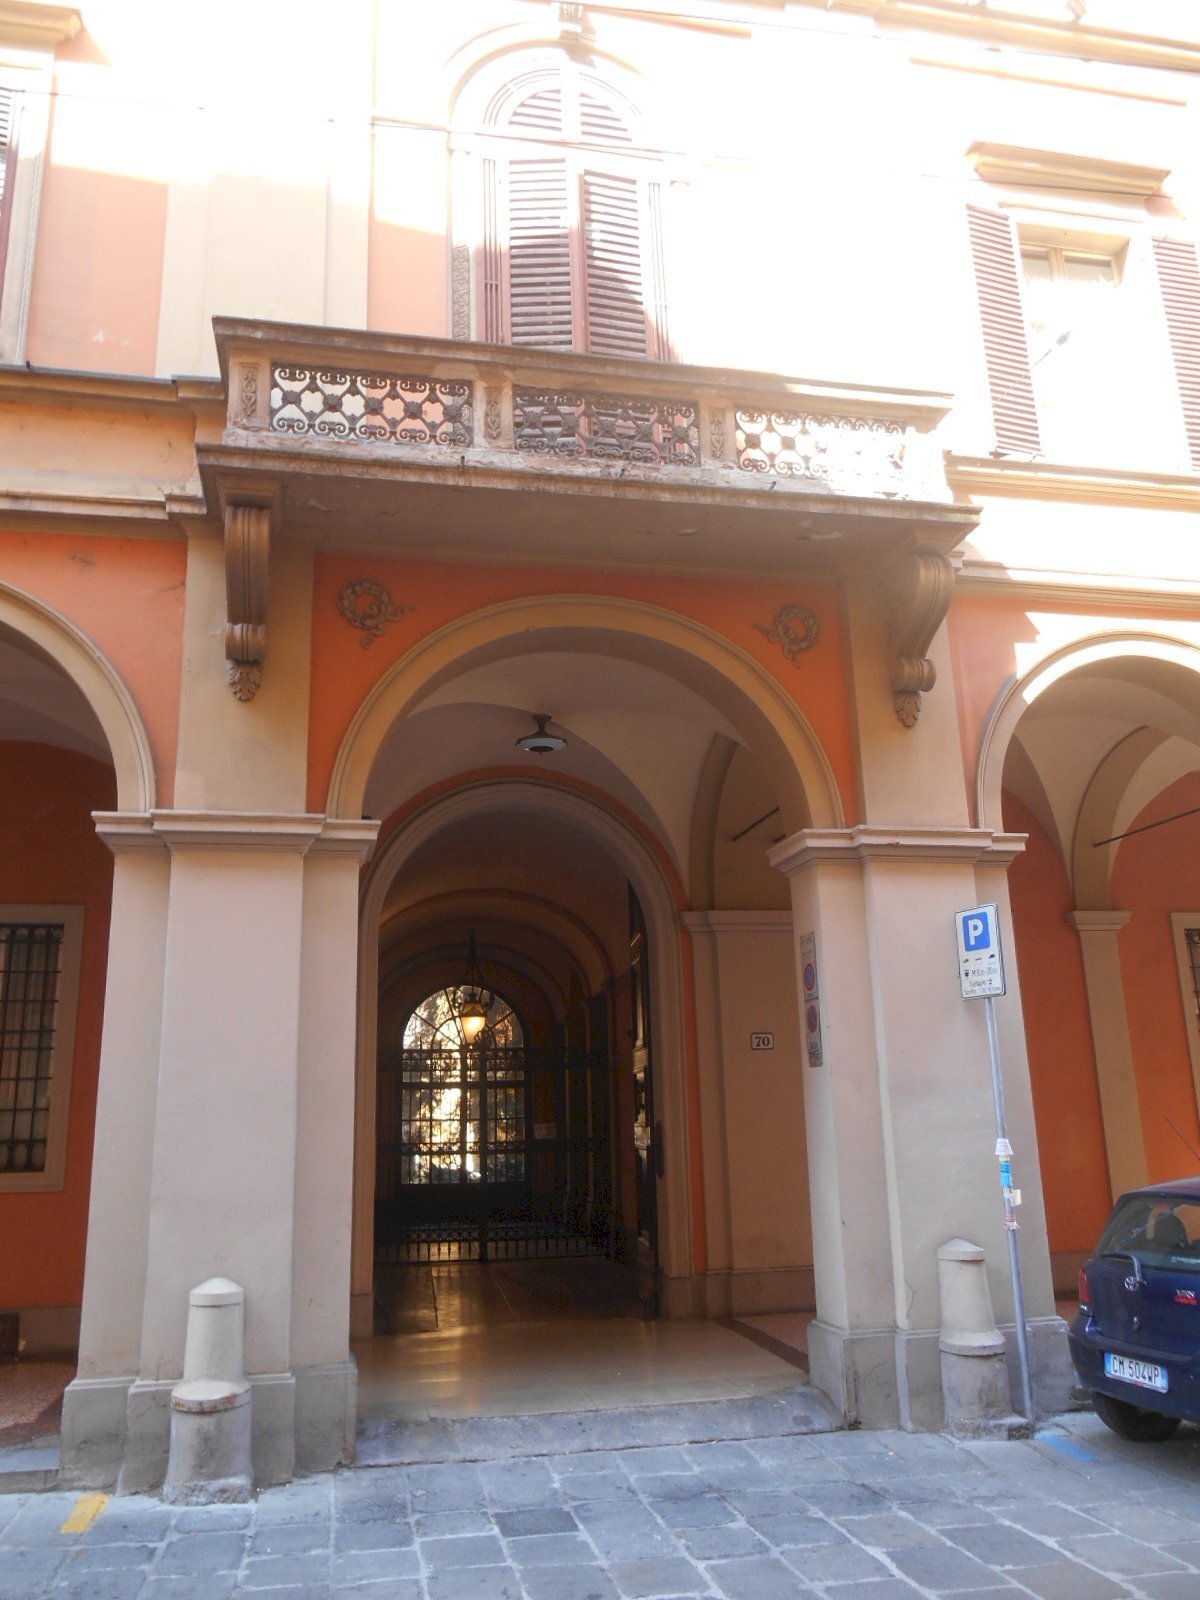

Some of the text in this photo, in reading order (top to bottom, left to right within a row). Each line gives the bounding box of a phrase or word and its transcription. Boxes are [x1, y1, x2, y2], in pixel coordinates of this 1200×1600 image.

[968, 919, 983, 945] P
[755, 1036, 770, 1047] 70
[1113, 1357, 1158, 1384] CM 504WP
